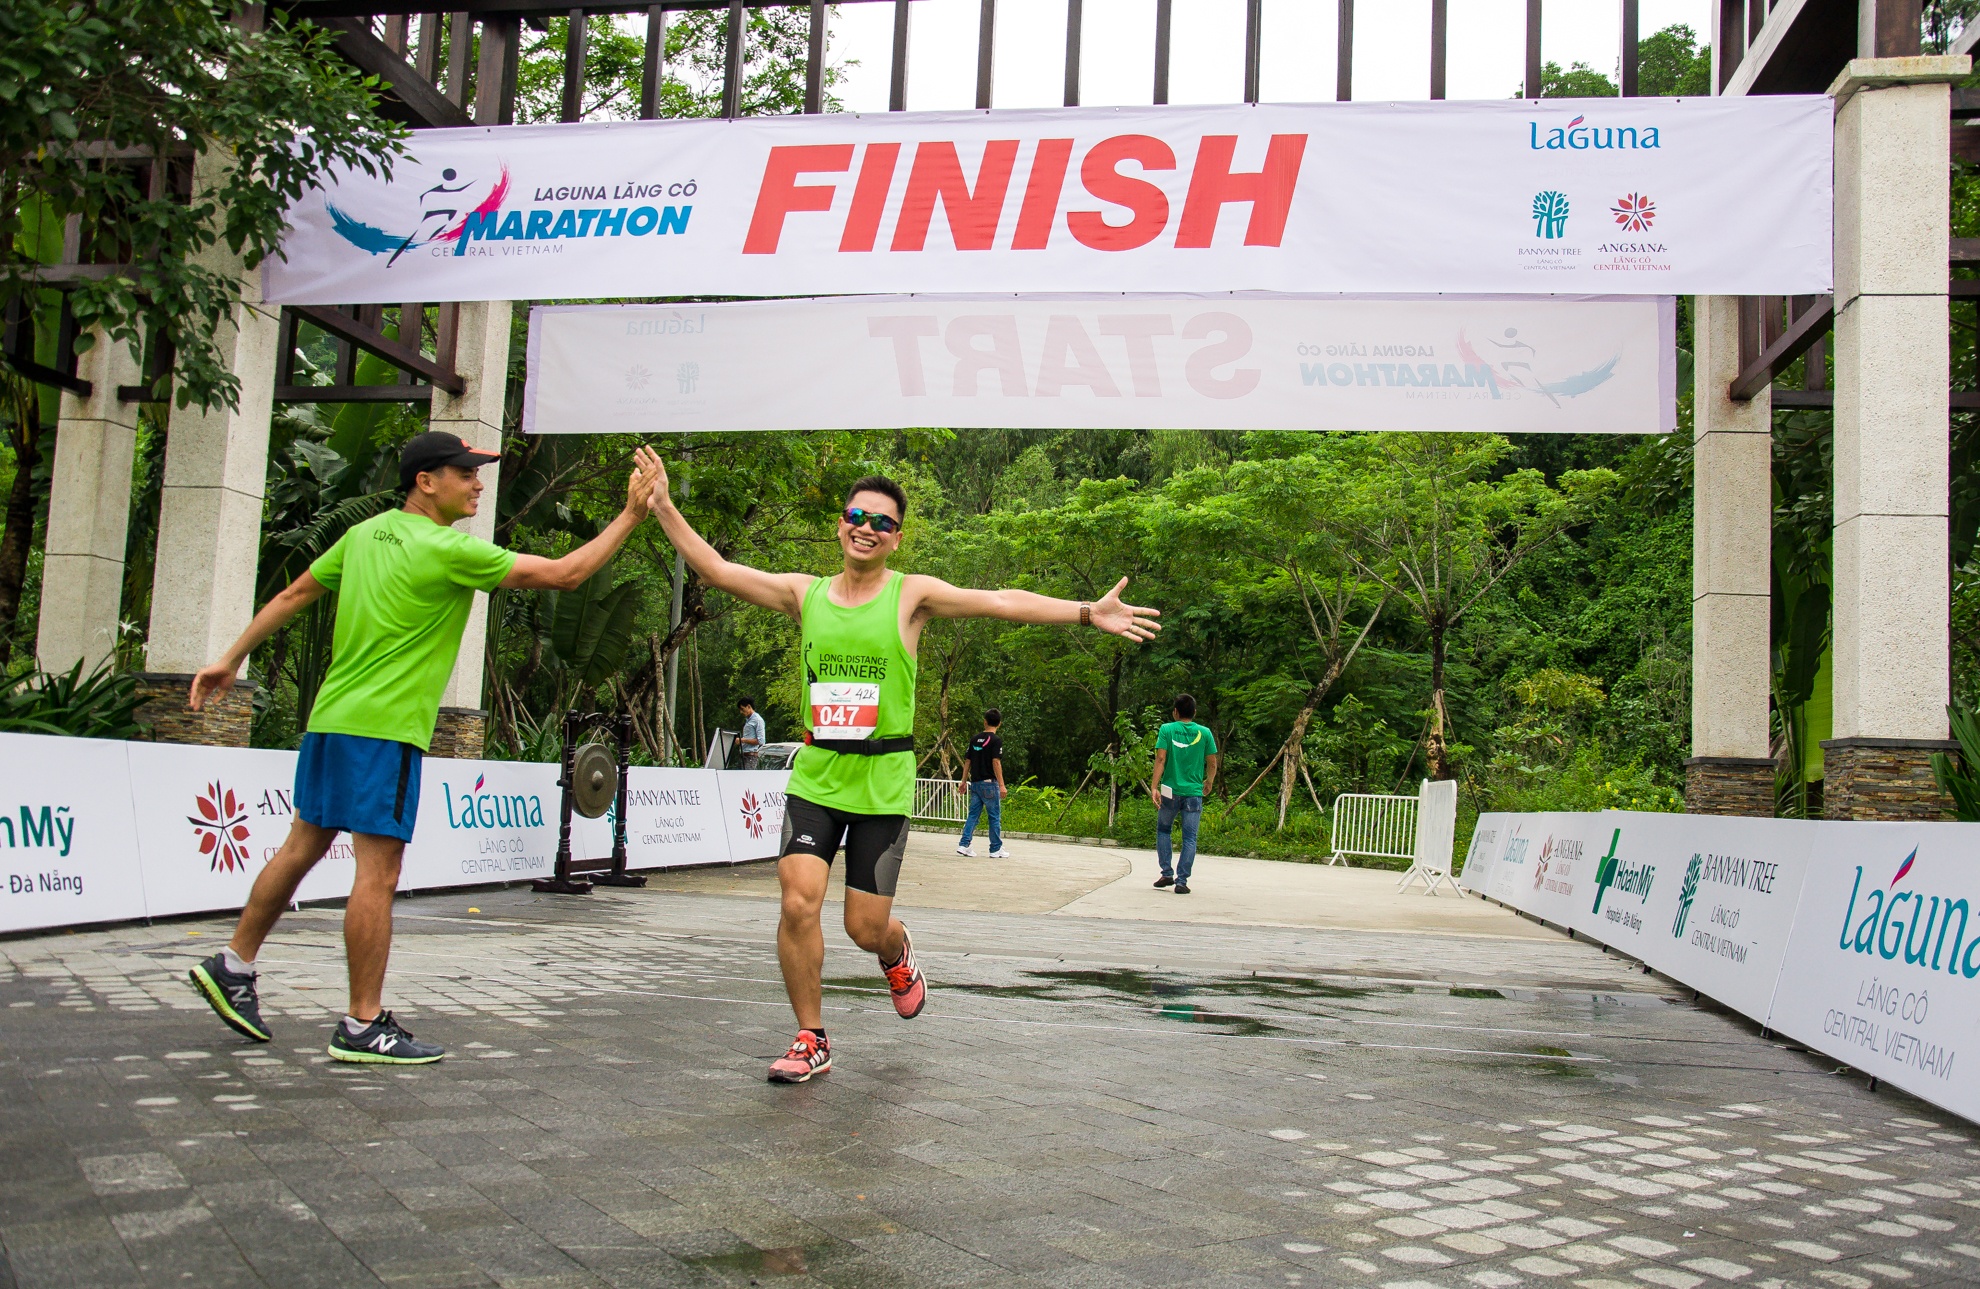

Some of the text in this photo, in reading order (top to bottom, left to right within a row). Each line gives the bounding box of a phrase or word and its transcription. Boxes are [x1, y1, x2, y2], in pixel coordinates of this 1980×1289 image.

[534, 179, 698, 202] LAGUNA LĂNG CÔ
[741, 133, 1309, 255] FINISH
[454, 205, 692, 256] MARATHON
[431, 244, 563, 258] CERAL VIETNAM
[1518, 248, 1582, 256] BANYAN TREE
[1598, 243, 1668, 253] ANGSANA
[1613, 255, 1651, 264] LĂNG CÔ
[820, 653, 888, 667] LONG DISTANCE
[819, 663, 886, 680] RUNNERS
[820, 705, 860, 725] 047
[627, 790, 701, 806] BANYAN TREE
[763, 792, 786, 807] ANGS
[0, 805, 74, 856] nMỹ
[642, 832, 702, 845] CENTRAL VIETNAM
[479, 836, 524, 854] LĂNG CÔ
[461, 856, 545, 874] CENTRAL VIETNAM
[1702, 853, 1778, 894] BANYAN TREE
[10, 874, 34, 894] Đà
[1691, 929, 1748, 964] CENTRAL VIETNAM
[1856, 977, 1928, 1025] LĂNG CÔ
[1823, 1009, 1955, 1081] CENTRAL VIETNAM
